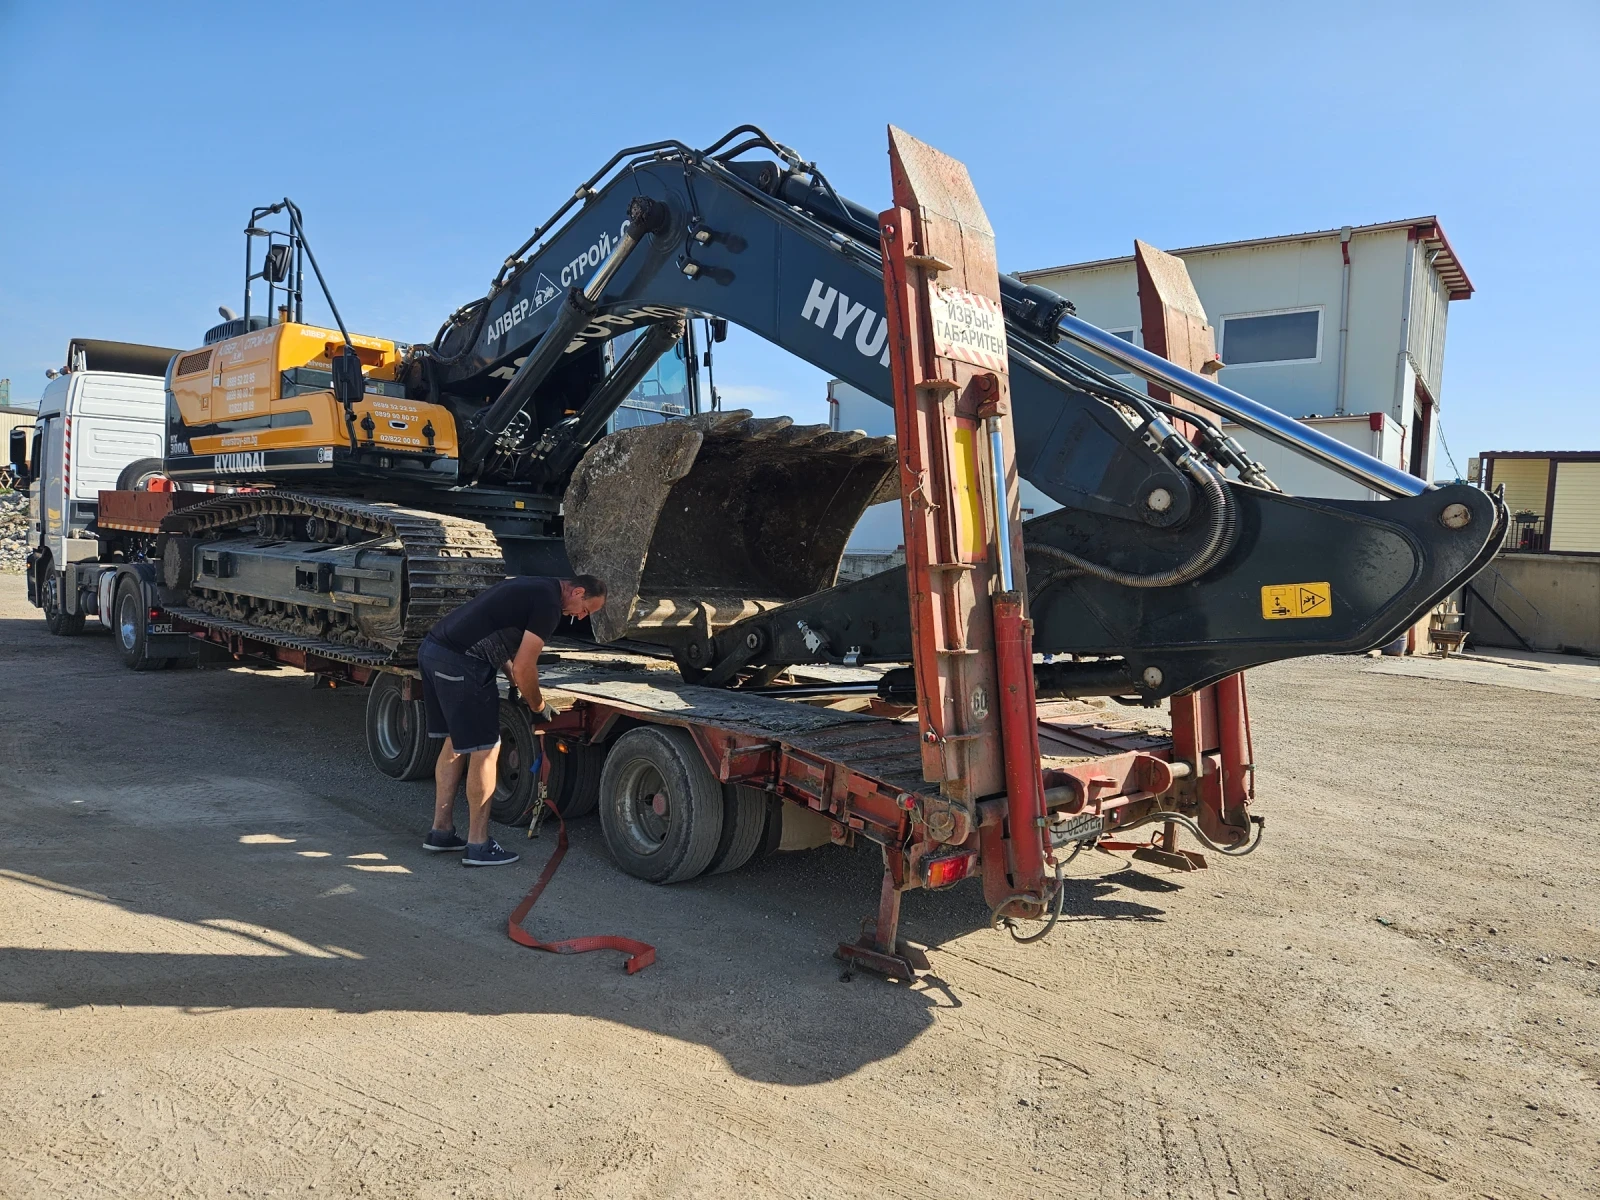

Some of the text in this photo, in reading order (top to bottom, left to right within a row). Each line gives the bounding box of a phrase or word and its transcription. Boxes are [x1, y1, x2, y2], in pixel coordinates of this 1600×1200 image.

[487, 298, 529, 345] АЛВЕР
[801, 278, 890, 368] HYU
[300, 328, 326, 339] АЛВЕР
[936, 319, 1004, 356] ГАБАРИТЕН
[380, 434, 402, 443] 02/822
[214, 451, 267, 474] HYUNDAI
[973, 691, 988, 711] 60
